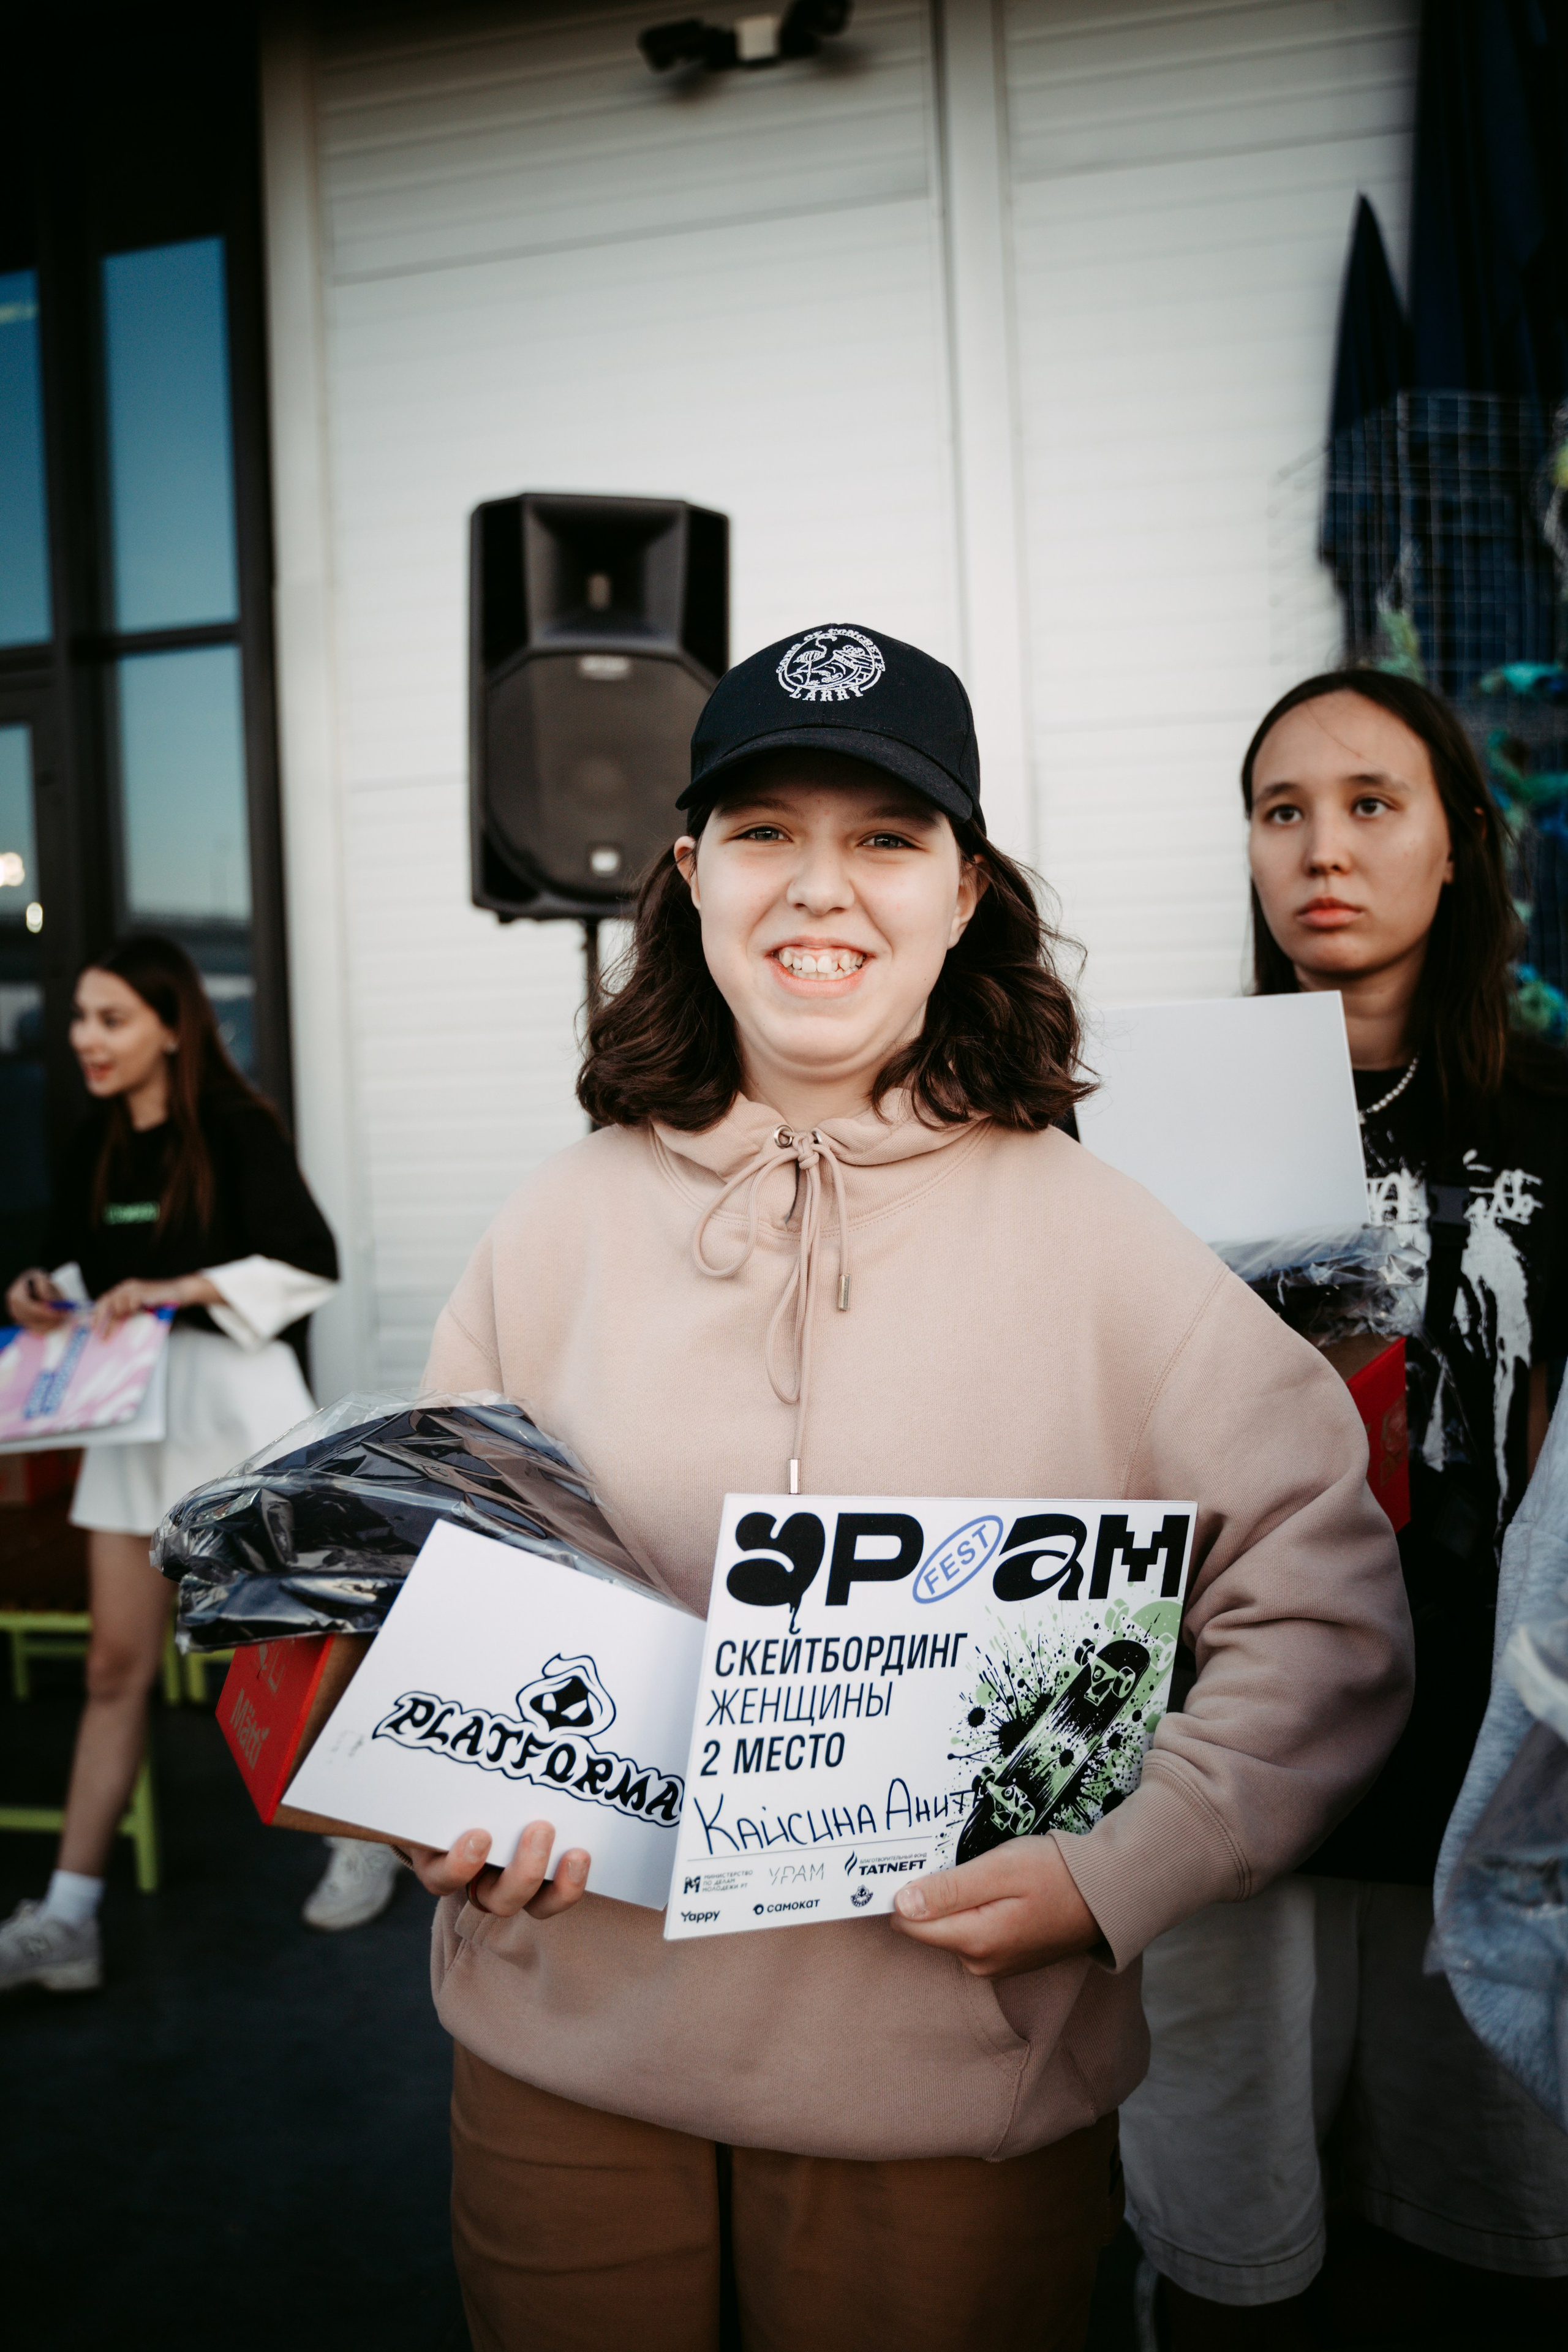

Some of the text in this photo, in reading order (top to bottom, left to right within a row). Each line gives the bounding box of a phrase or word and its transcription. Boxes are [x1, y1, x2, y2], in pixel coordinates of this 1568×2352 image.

[922, 1523, 991, 1596] FEST
[715, 1630, 968, 1677] СКЕЙТБОРДИНГ
[706, 1681, 892, 1727] ЖЕНЩИНЫ
[384, 1696, 685, 1822] PLATFORMA
[700, 1732, 846, 1777] 2 МЕСТО
[859, 1859, 927, 1875] TATNEFT
[860, 1853, 913, 1864] БЛАГОТВОРИТЕЛЬНЫЙ
[704, 1870, 753, 1879] МИНИСТЕРСТВО
[680, 1910, 720, 1923] Yappy
[767, 1899, 820, 1912] самокат
